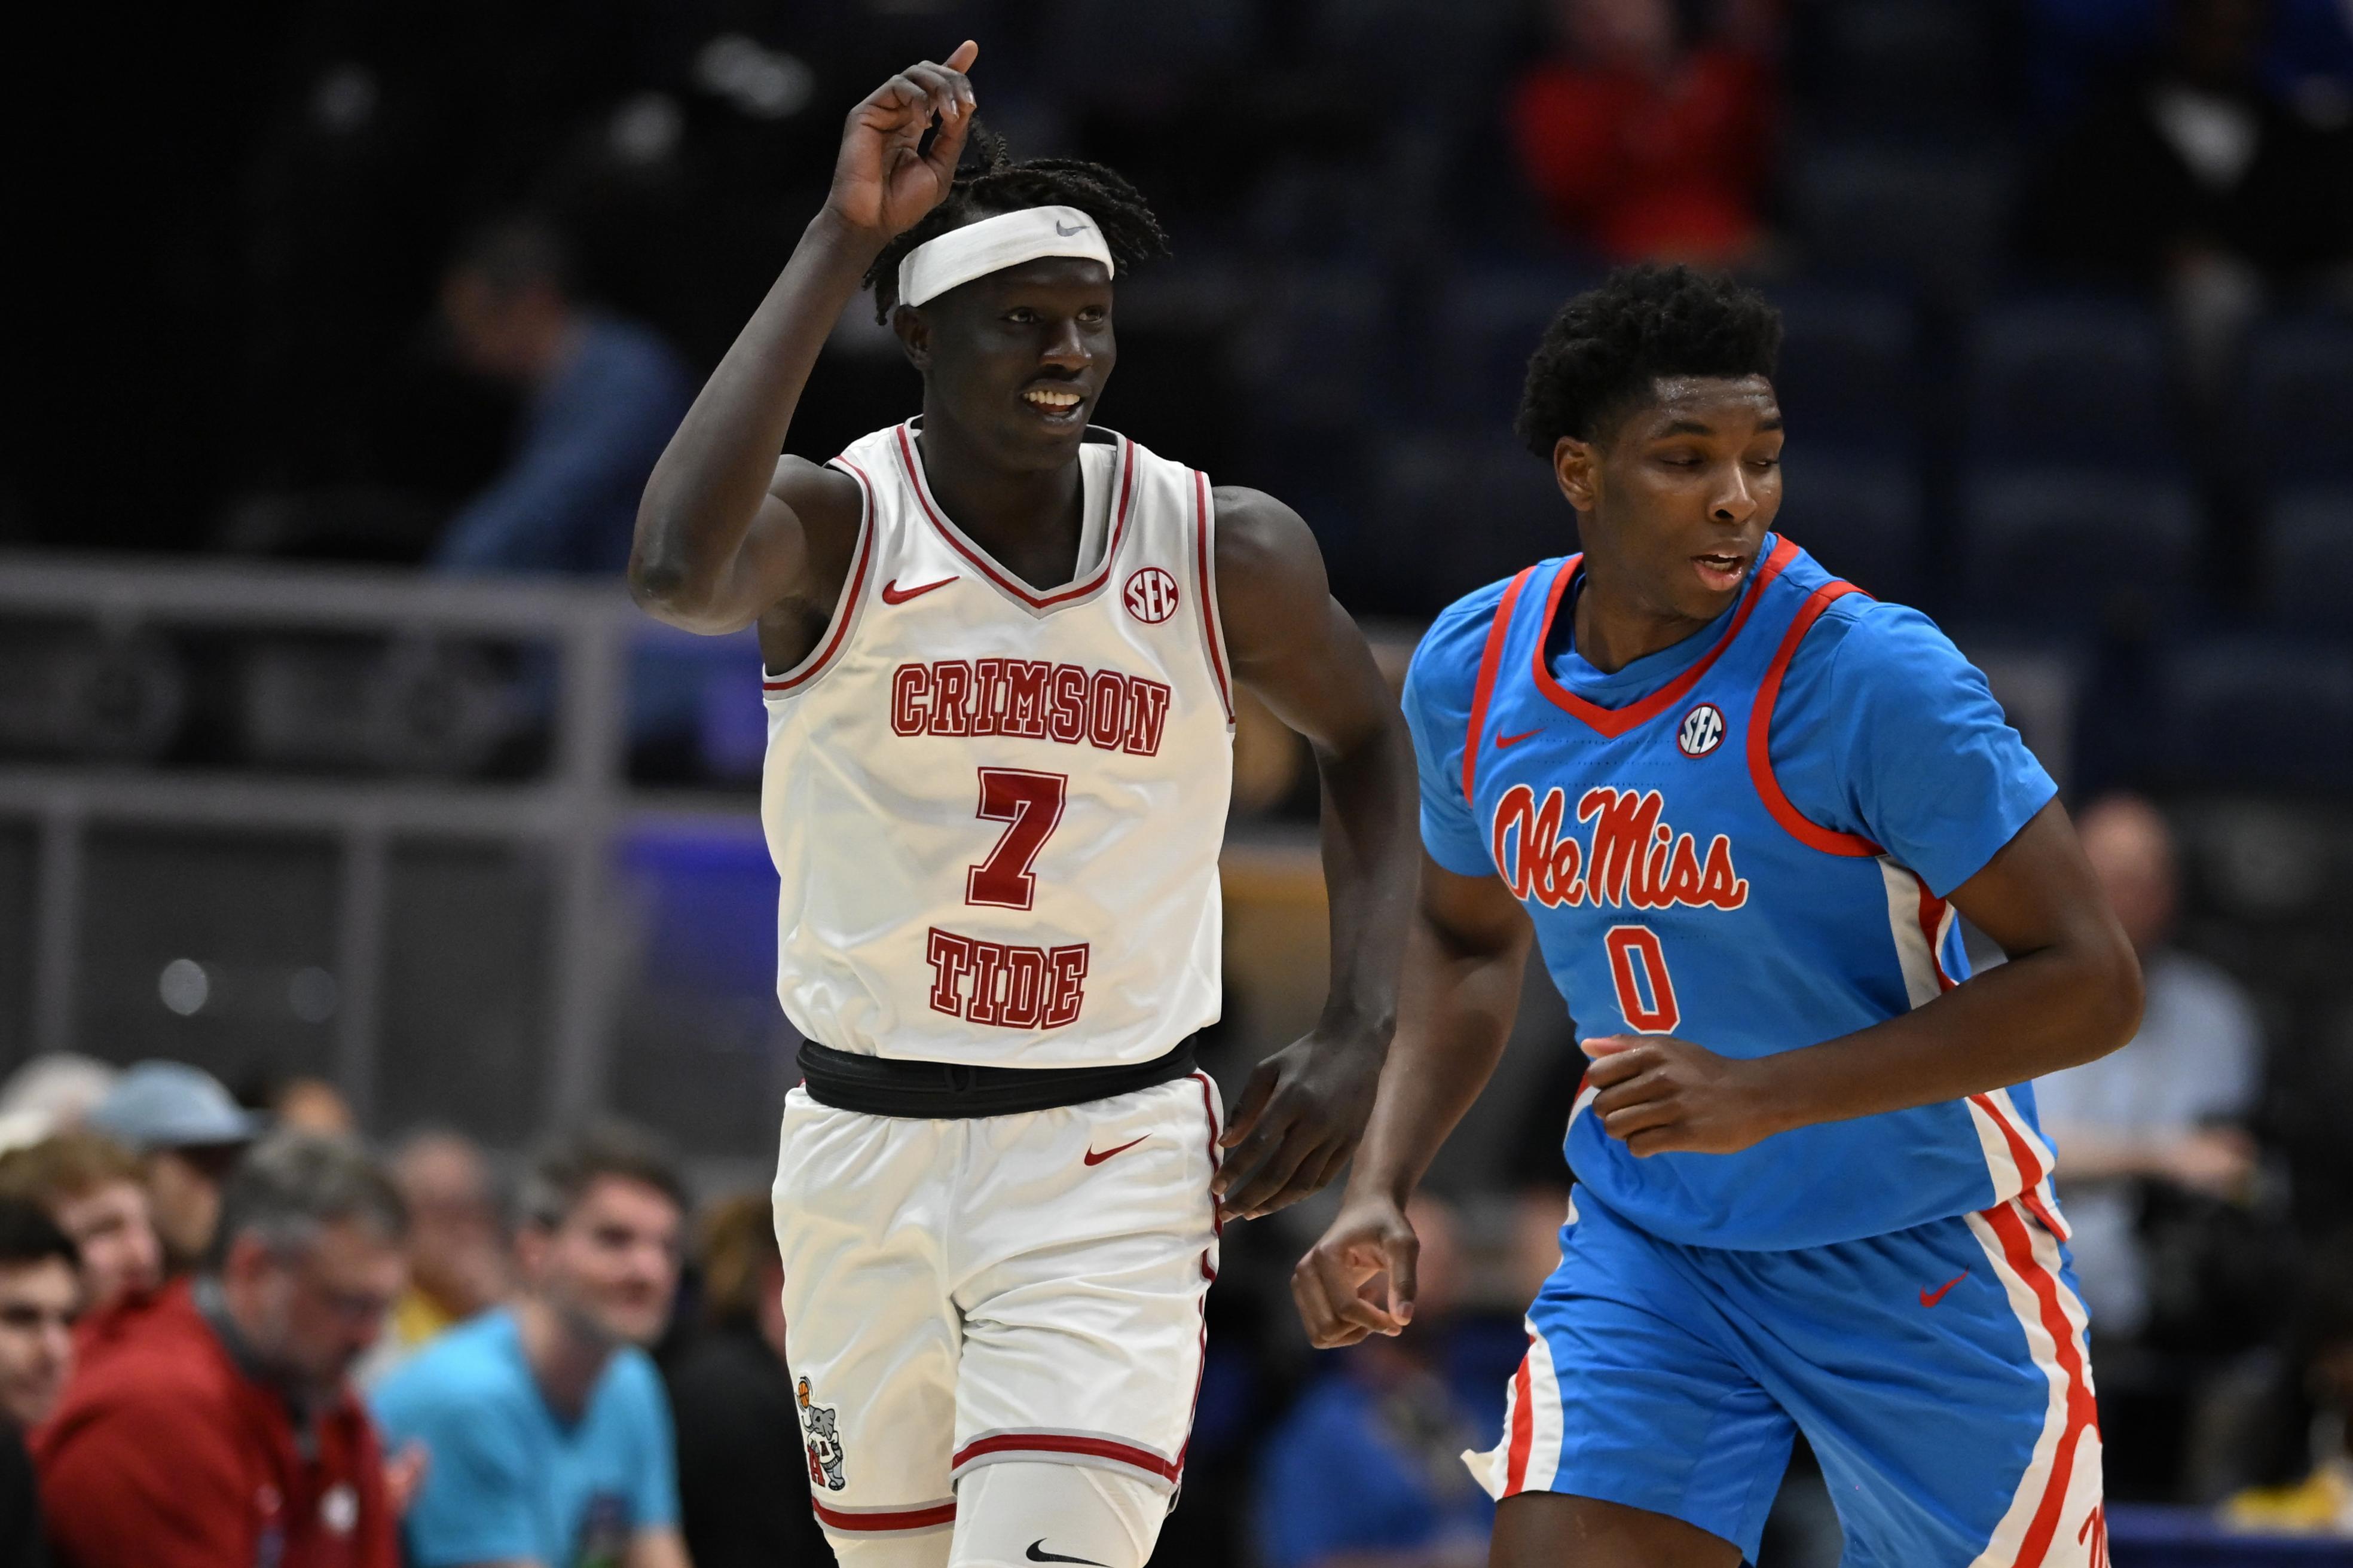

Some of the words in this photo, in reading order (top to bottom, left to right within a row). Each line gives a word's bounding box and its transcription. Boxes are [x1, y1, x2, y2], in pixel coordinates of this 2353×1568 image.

[1126, 570, 1176, 621] SEC
[891, 658, 1171, 757] CRIMSON
[1679, 706, 1722, 754] SEC
[965, 766, 1069, 911] 7
[1492, 783, 1586, 909] Ole
[1577, 785, 1749, 911] Miss
[927, 927, 1090, 1030] TIDE
[1604, 925, 1680, 1035] 0
